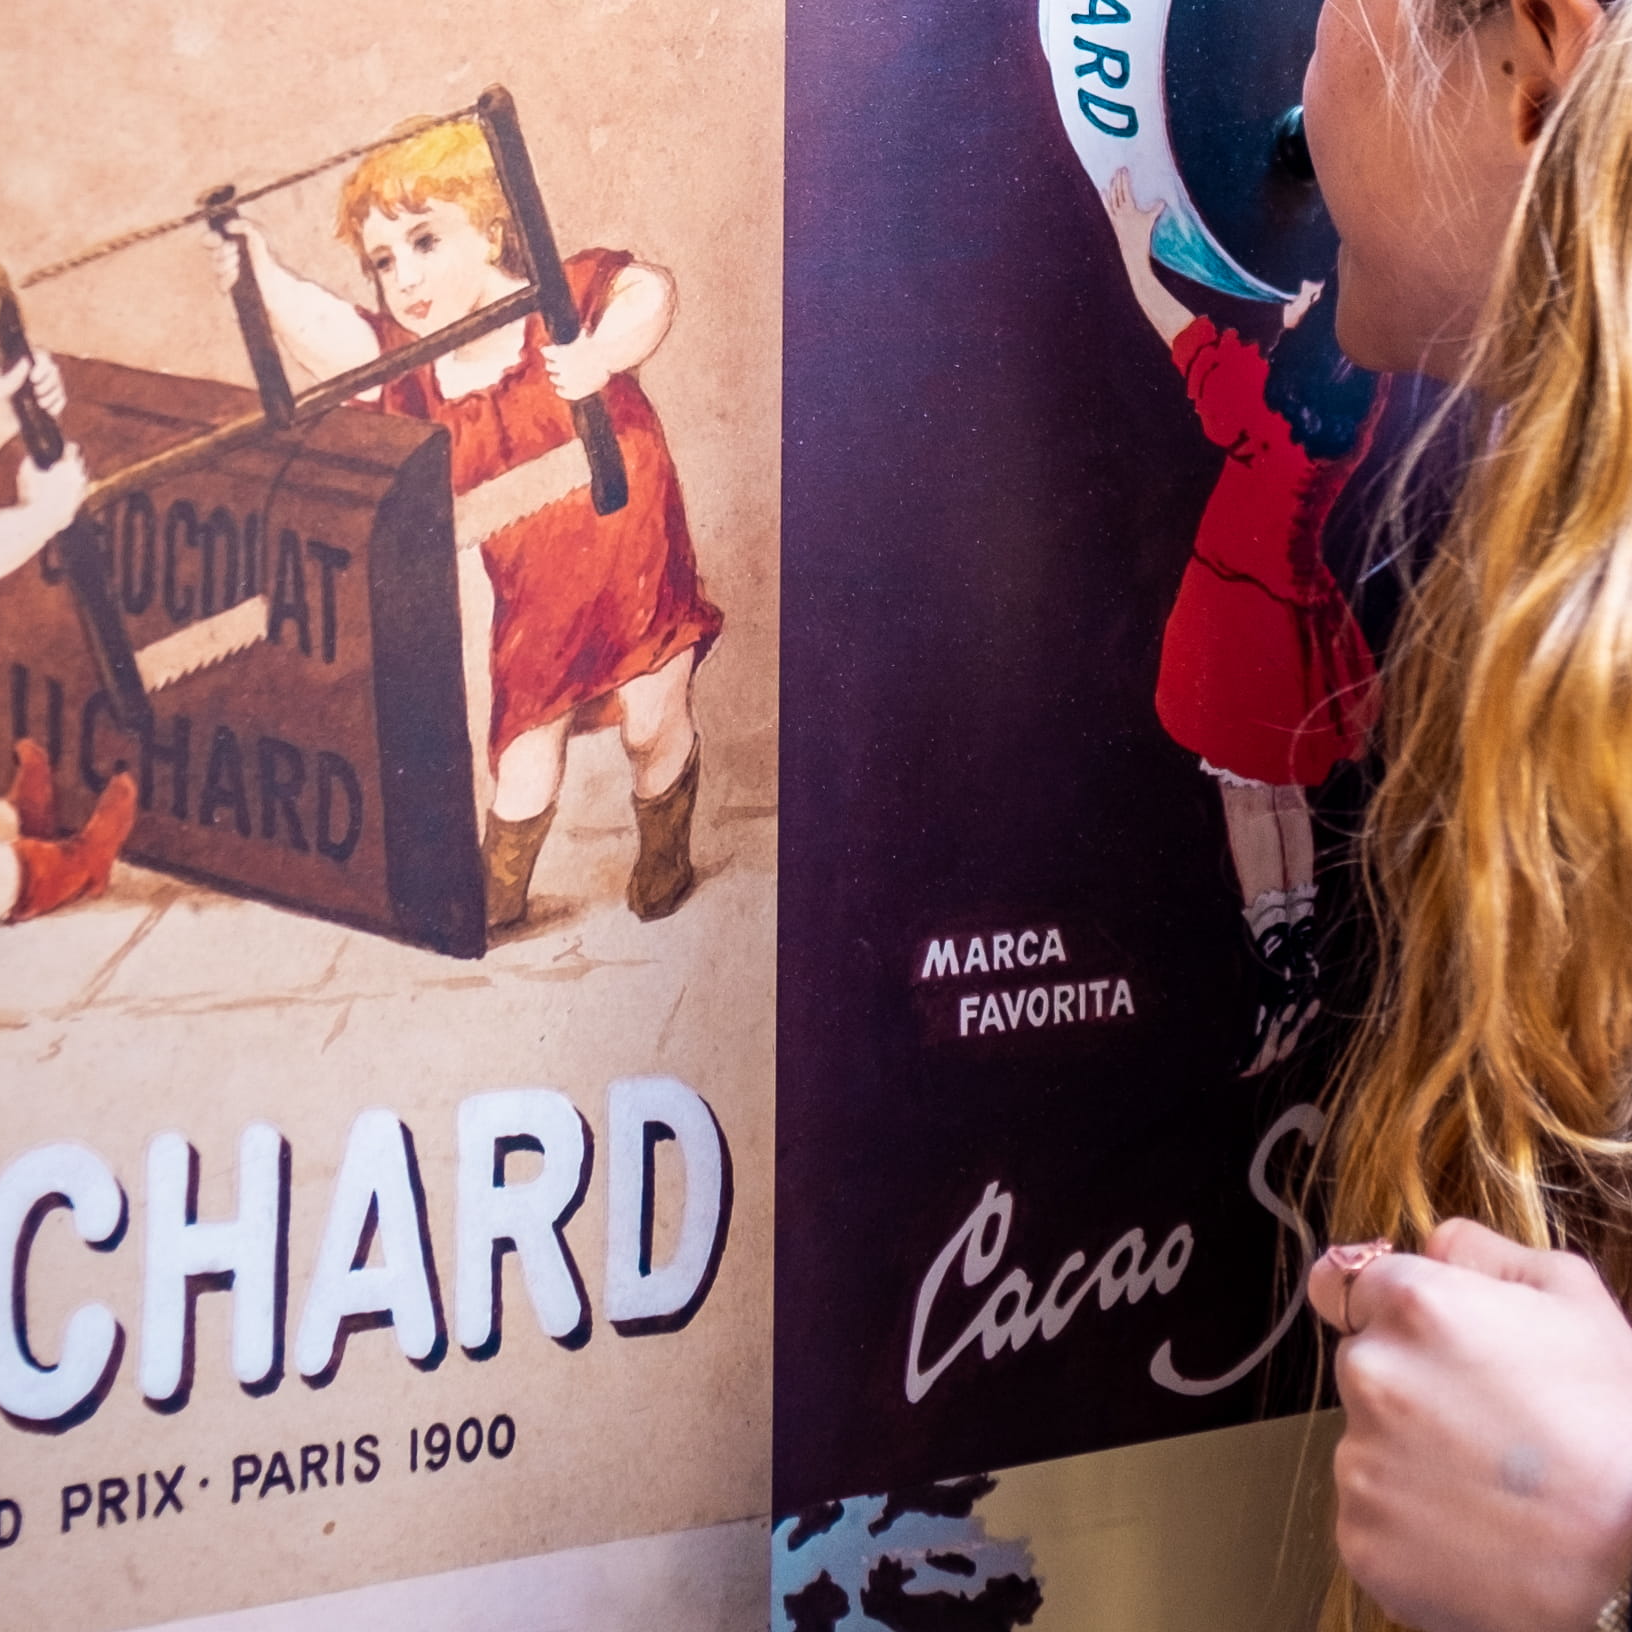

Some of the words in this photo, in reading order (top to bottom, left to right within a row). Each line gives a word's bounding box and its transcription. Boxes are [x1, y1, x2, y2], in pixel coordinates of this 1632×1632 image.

[921, 928, 1067, 978] MARCA
[959, 977, 1136, 1037] FAVORITA
[905, 1181, 1194, 1405] Cacao
[59, 1467, 186, 1536] PRIX
[229, 1434, 383, 1505] PARIS
[407, 1414, 518, 1473] 1900
